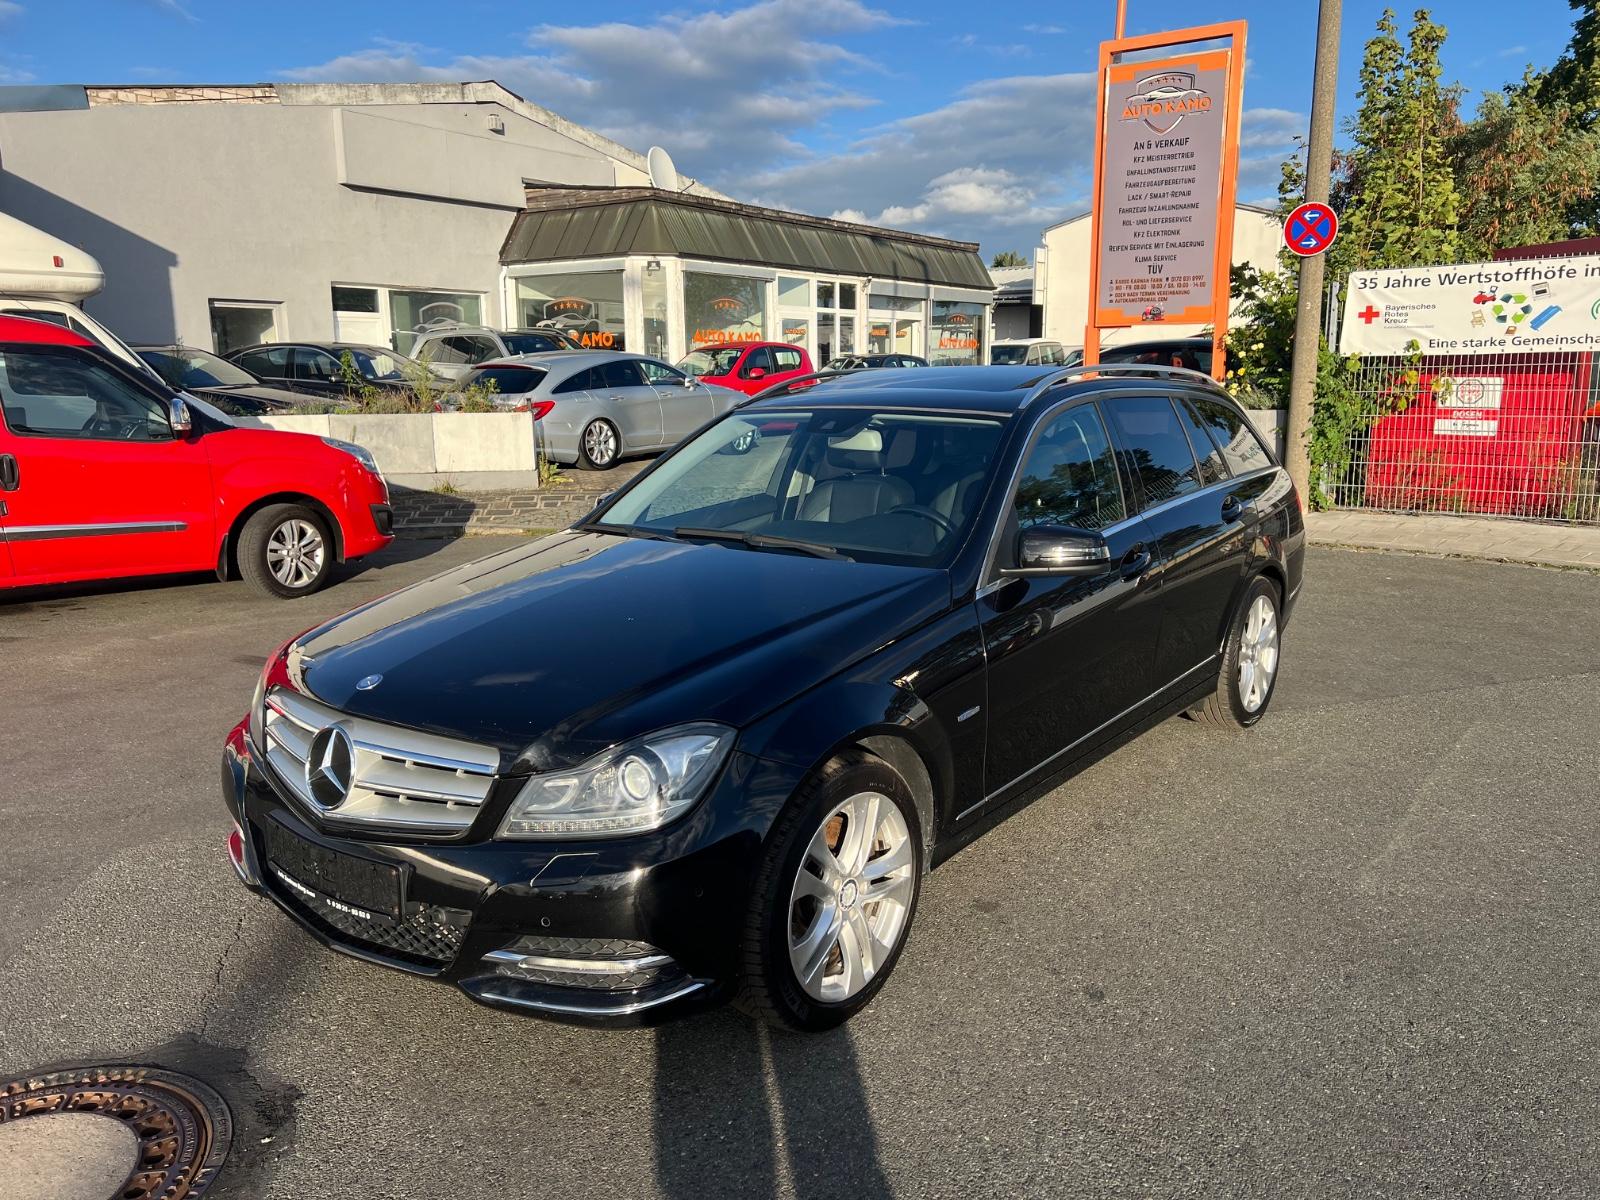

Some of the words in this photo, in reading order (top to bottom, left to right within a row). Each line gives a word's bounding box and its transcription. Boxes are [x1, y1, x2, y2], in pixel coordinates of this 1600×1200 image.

[1123, 102, 1162, 119] AUTO
[1166, 97, 1212, 113] KAMO
[1133, 141, 1145, 151] AN
[1147, 140, 1152, 149] &
[1155, 137, 1190, 149] VERKAUF
[1133, 155, 1145, 163] KFZ
[1147, 151, 1195, 162] MEISTERBETRIEB
[1126, 164, 1197, 176] UNFALLINSTANDSETZUNG
[1125, 177, 1196, 189] FAHRZEUGAUFBEREITUNG
[1127, 194, 1143, 202] LACK
[1149, 190, 1192, 199] SMART-REPAIR
[1118, 206, 1147, 214] FAHRZEUG
[1136, 218, 1148, 226] UND
[1148, 216, 1193, 225] LIEFERSERVICE
[1146, 229, 1181, 238] ELEKTRONIK
[1129, 243, 1153, 251] SERVICE
[1165, 240, 1205, 248] EINLAGERUNG
[1153, 254, 1177, 262] SERVICE
[1147, 262, 1164, 274] TÜV
[1358, 277, 1379, 290] 35
[1384, 275, 1431, 289] Jahre
[1438, 265, 1577, 286] Wertstoffhöfe
[693, 329, 726, 343] AUTO
[728, 331, 762, 342] KAMO
[1429, 339, 1458, 349] Eine
[1461, 337, 1507, 348] starke
[1452, 410, 1483, 419] DOSEN
